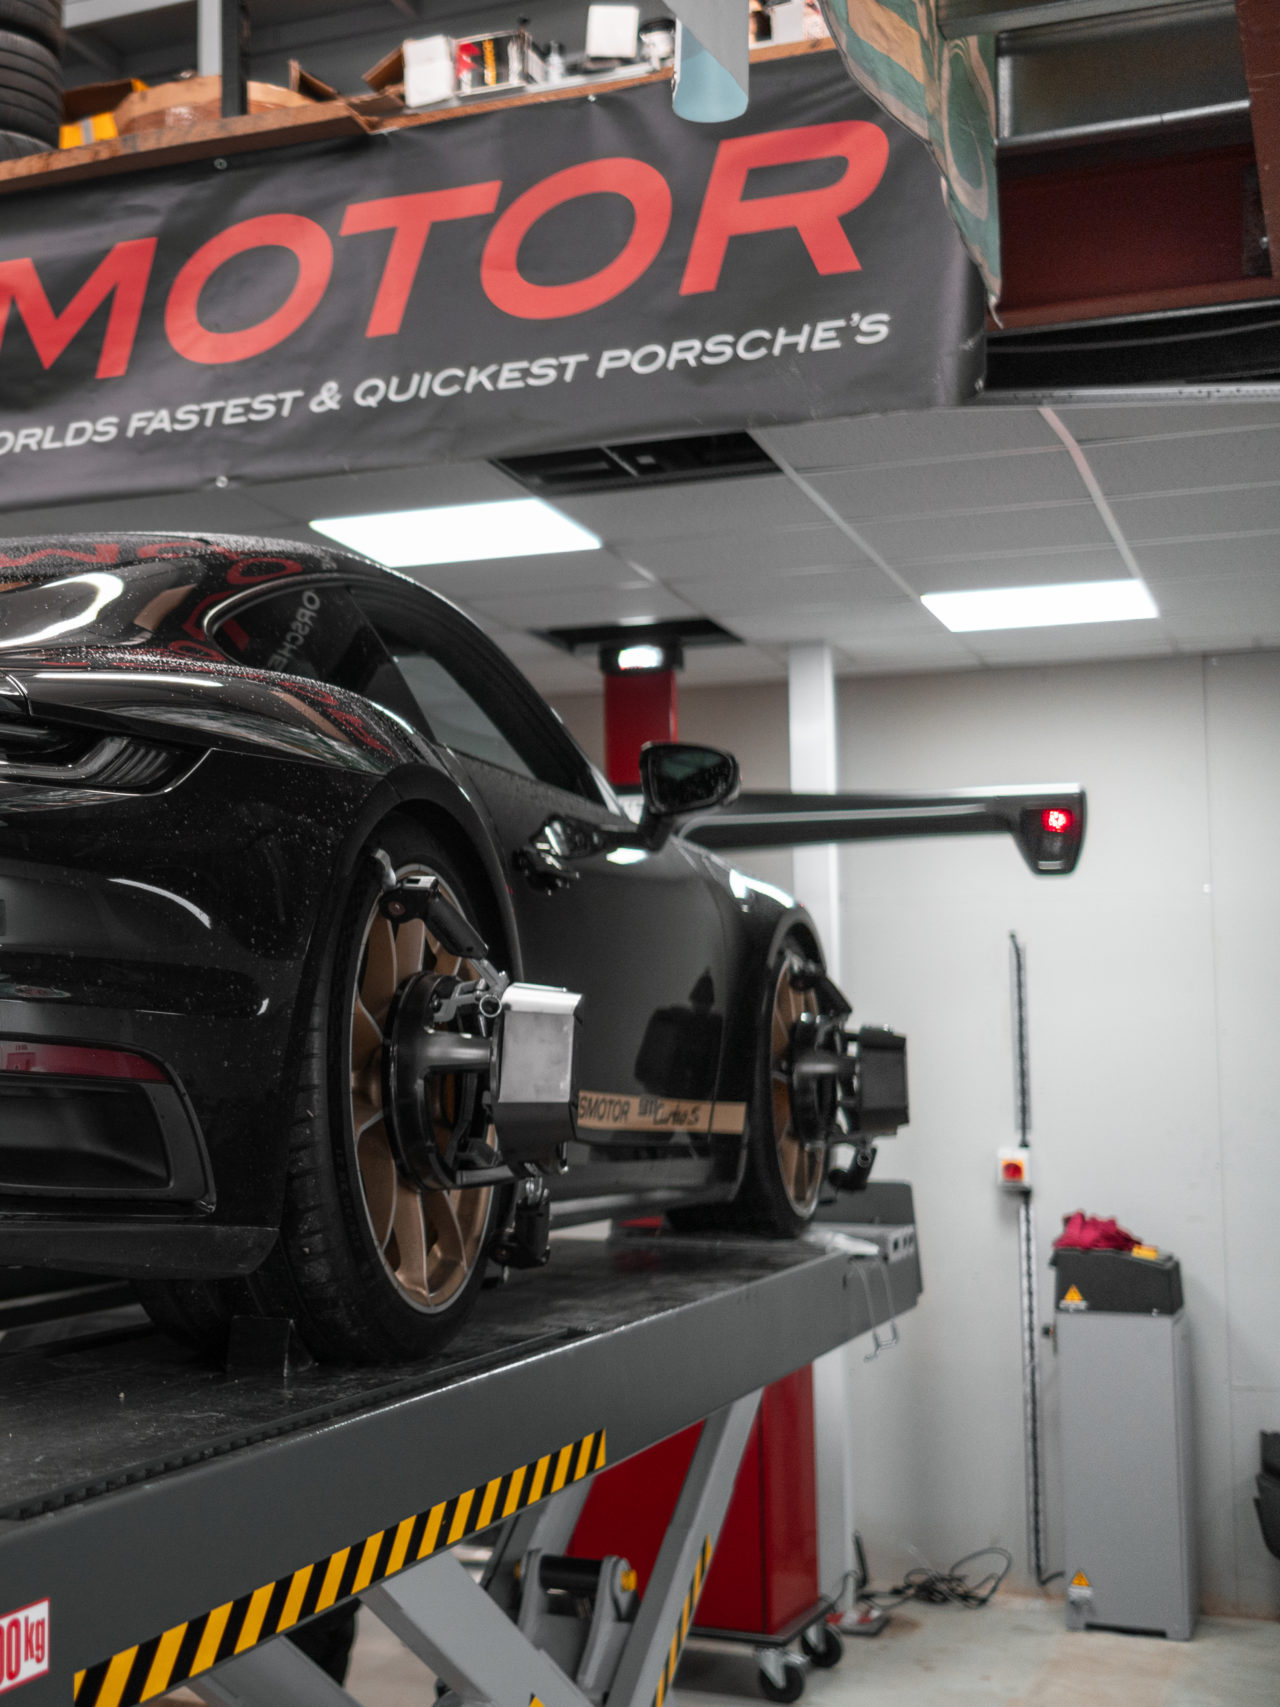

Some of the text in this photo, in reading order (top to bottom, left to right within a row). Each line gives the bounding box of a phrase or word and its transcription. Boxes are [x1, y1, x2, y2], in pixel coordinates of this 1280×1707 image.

[126, 390, 305, 438] FASTEST
[309, 381, 341, 413] &
[353, 353, 589, 408] QUICKEST
[596, 312, 891, 379] PORSCHE'S
